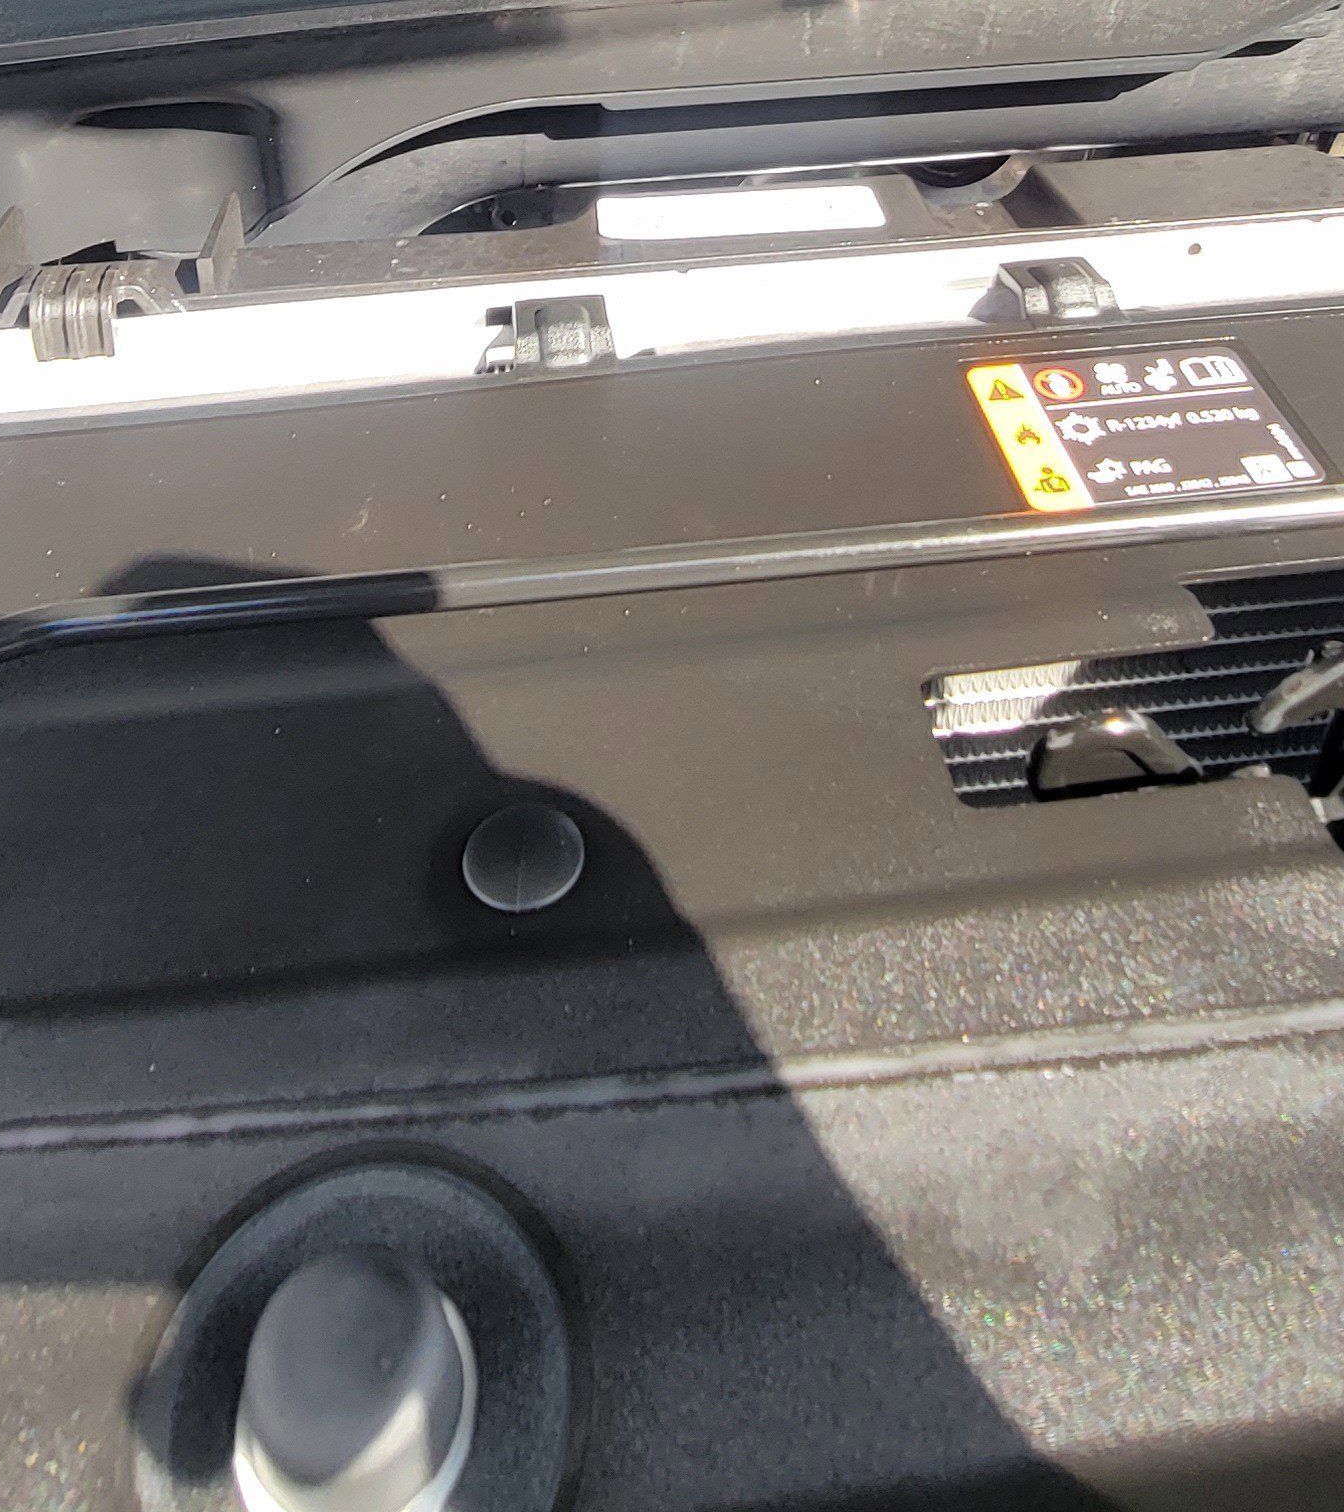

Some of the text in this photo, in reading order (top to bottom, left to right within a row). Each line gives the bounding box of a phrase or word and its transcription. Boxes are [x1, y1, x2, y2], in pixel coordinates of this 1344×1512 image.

[1100, 381, 1143, 396] AUTO
[1106, 412, 1183, 433] R-1234yf
[1185, 408, 1235, 424] 0.520
[1129, 458, 1173, 476] PAG
